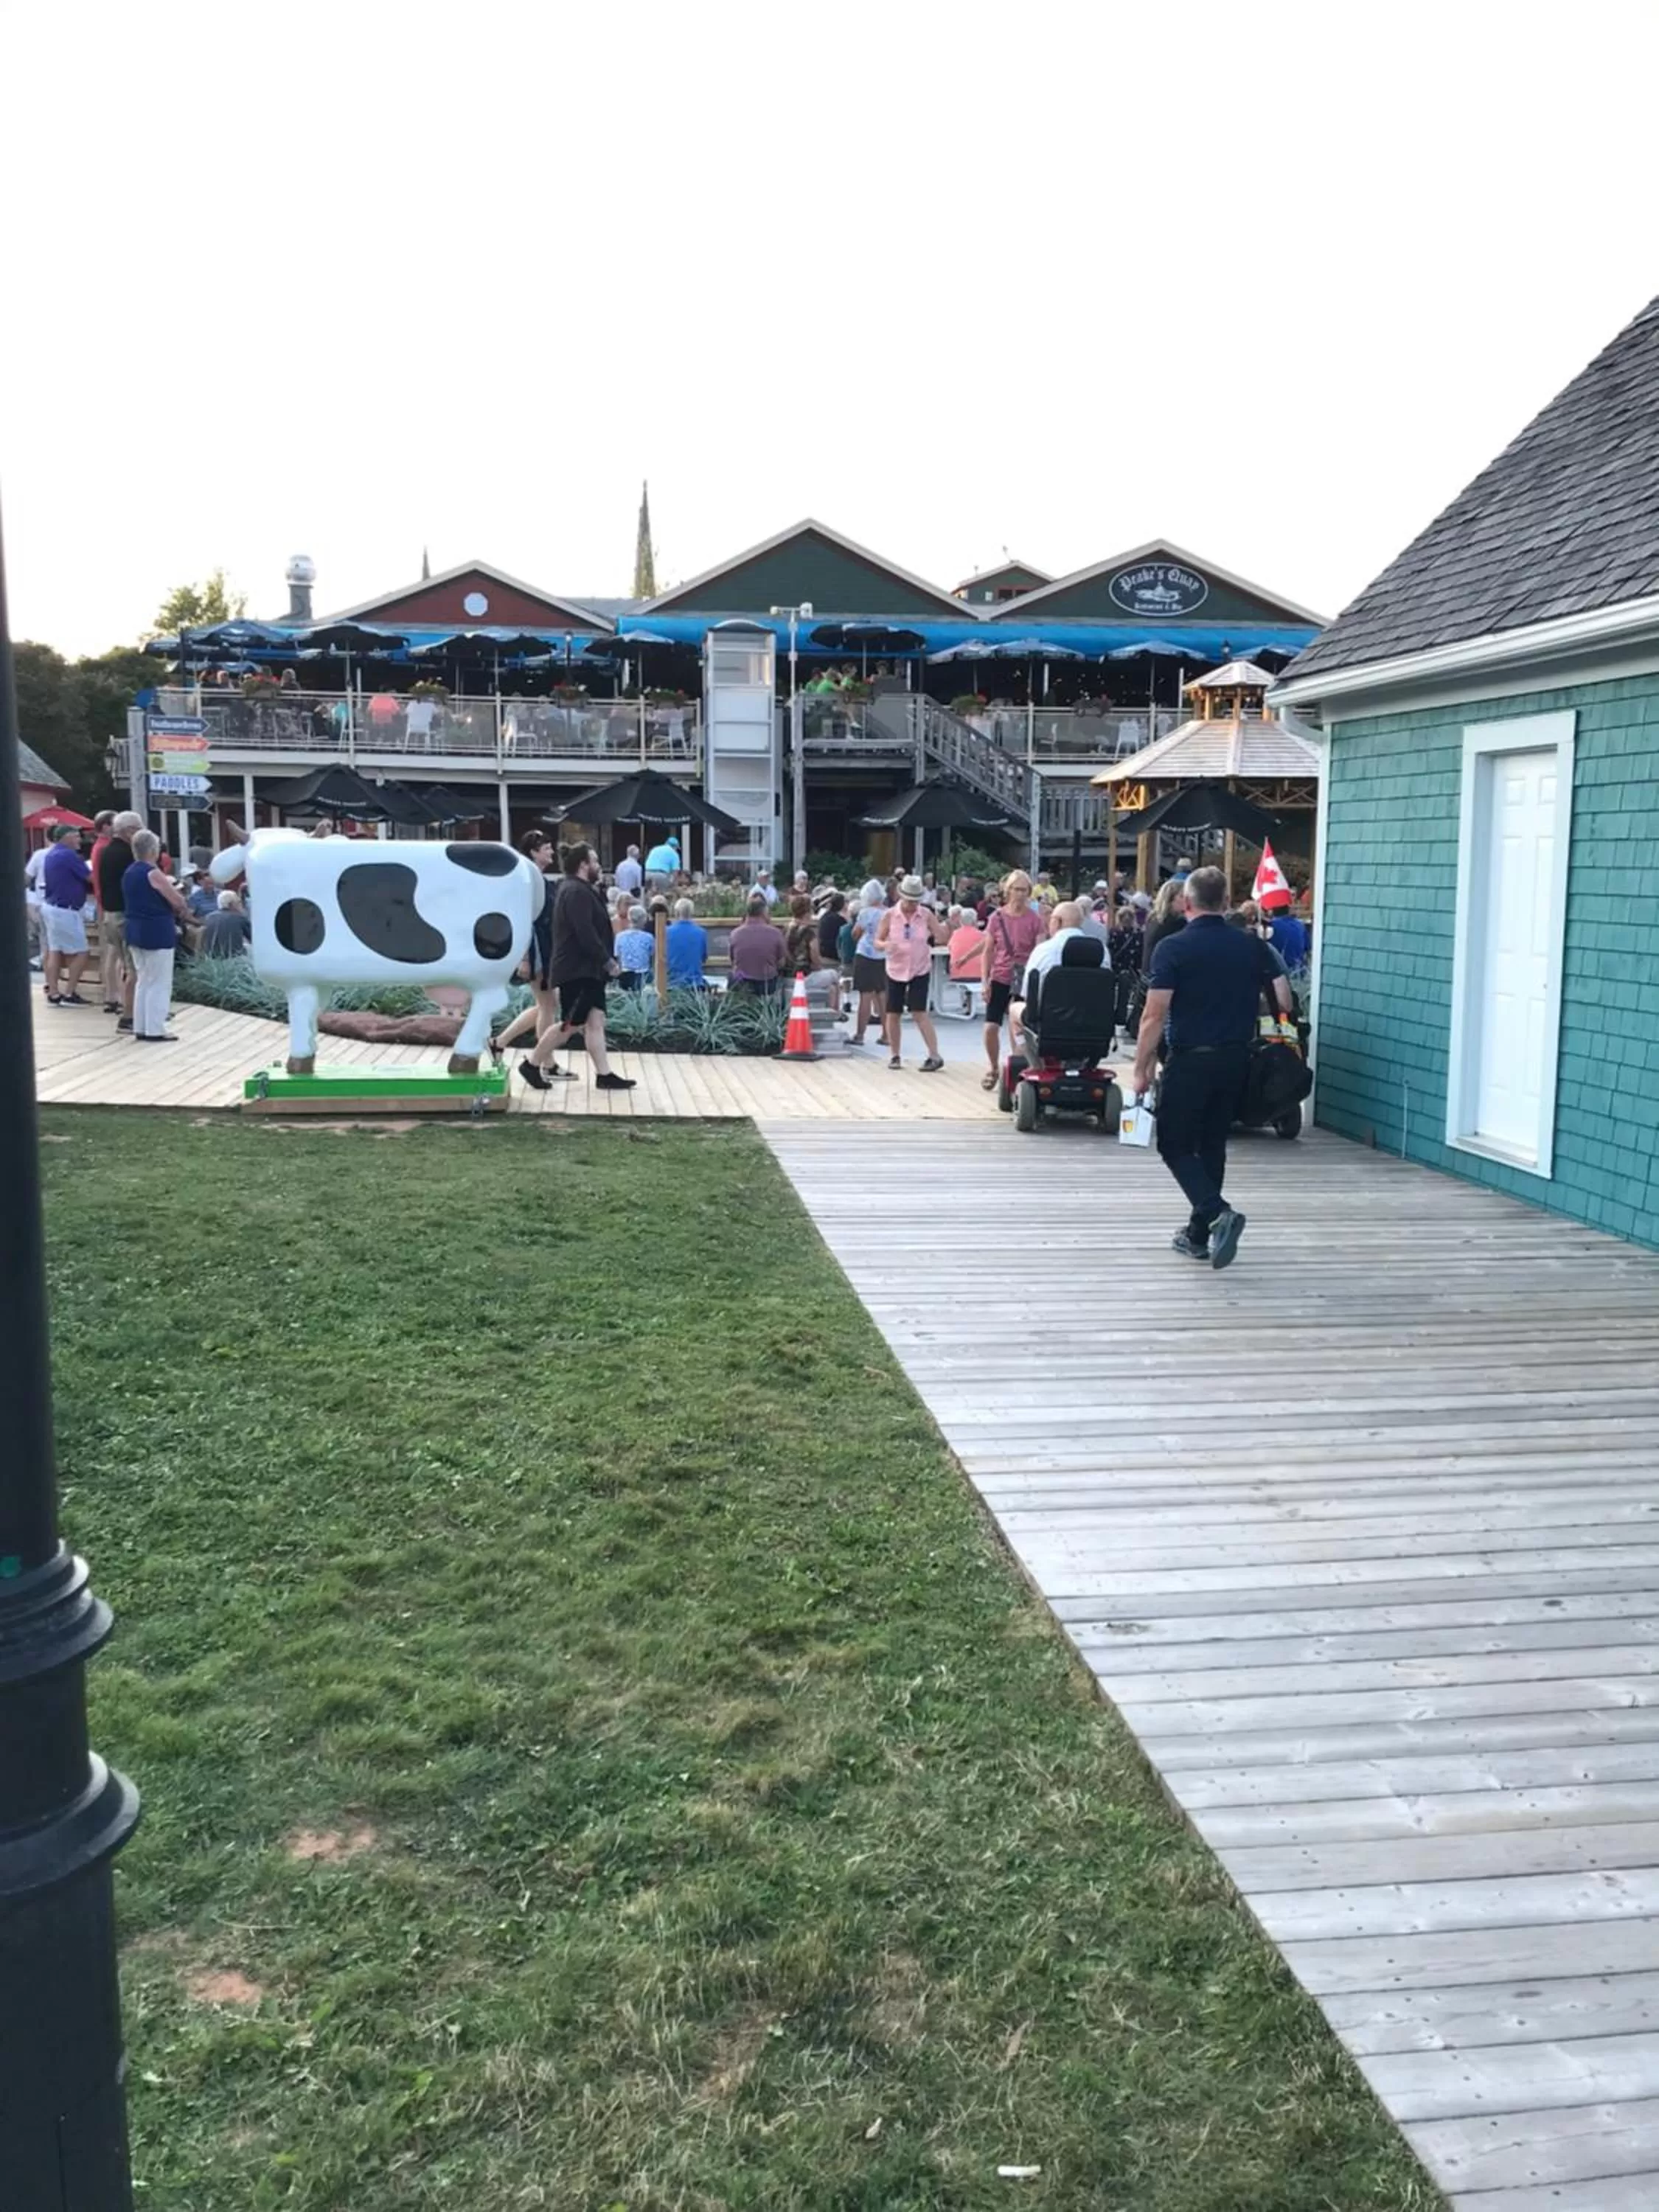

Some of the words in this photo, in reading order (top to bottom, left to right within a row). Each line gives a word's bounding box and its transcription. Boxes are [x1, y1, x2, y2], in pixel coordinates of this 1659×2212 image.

[1119, 566, 1165, 593] Peake's
[1168, 567, 1200, 592] Quay
[154, 776, 199, 788] PADDLES
